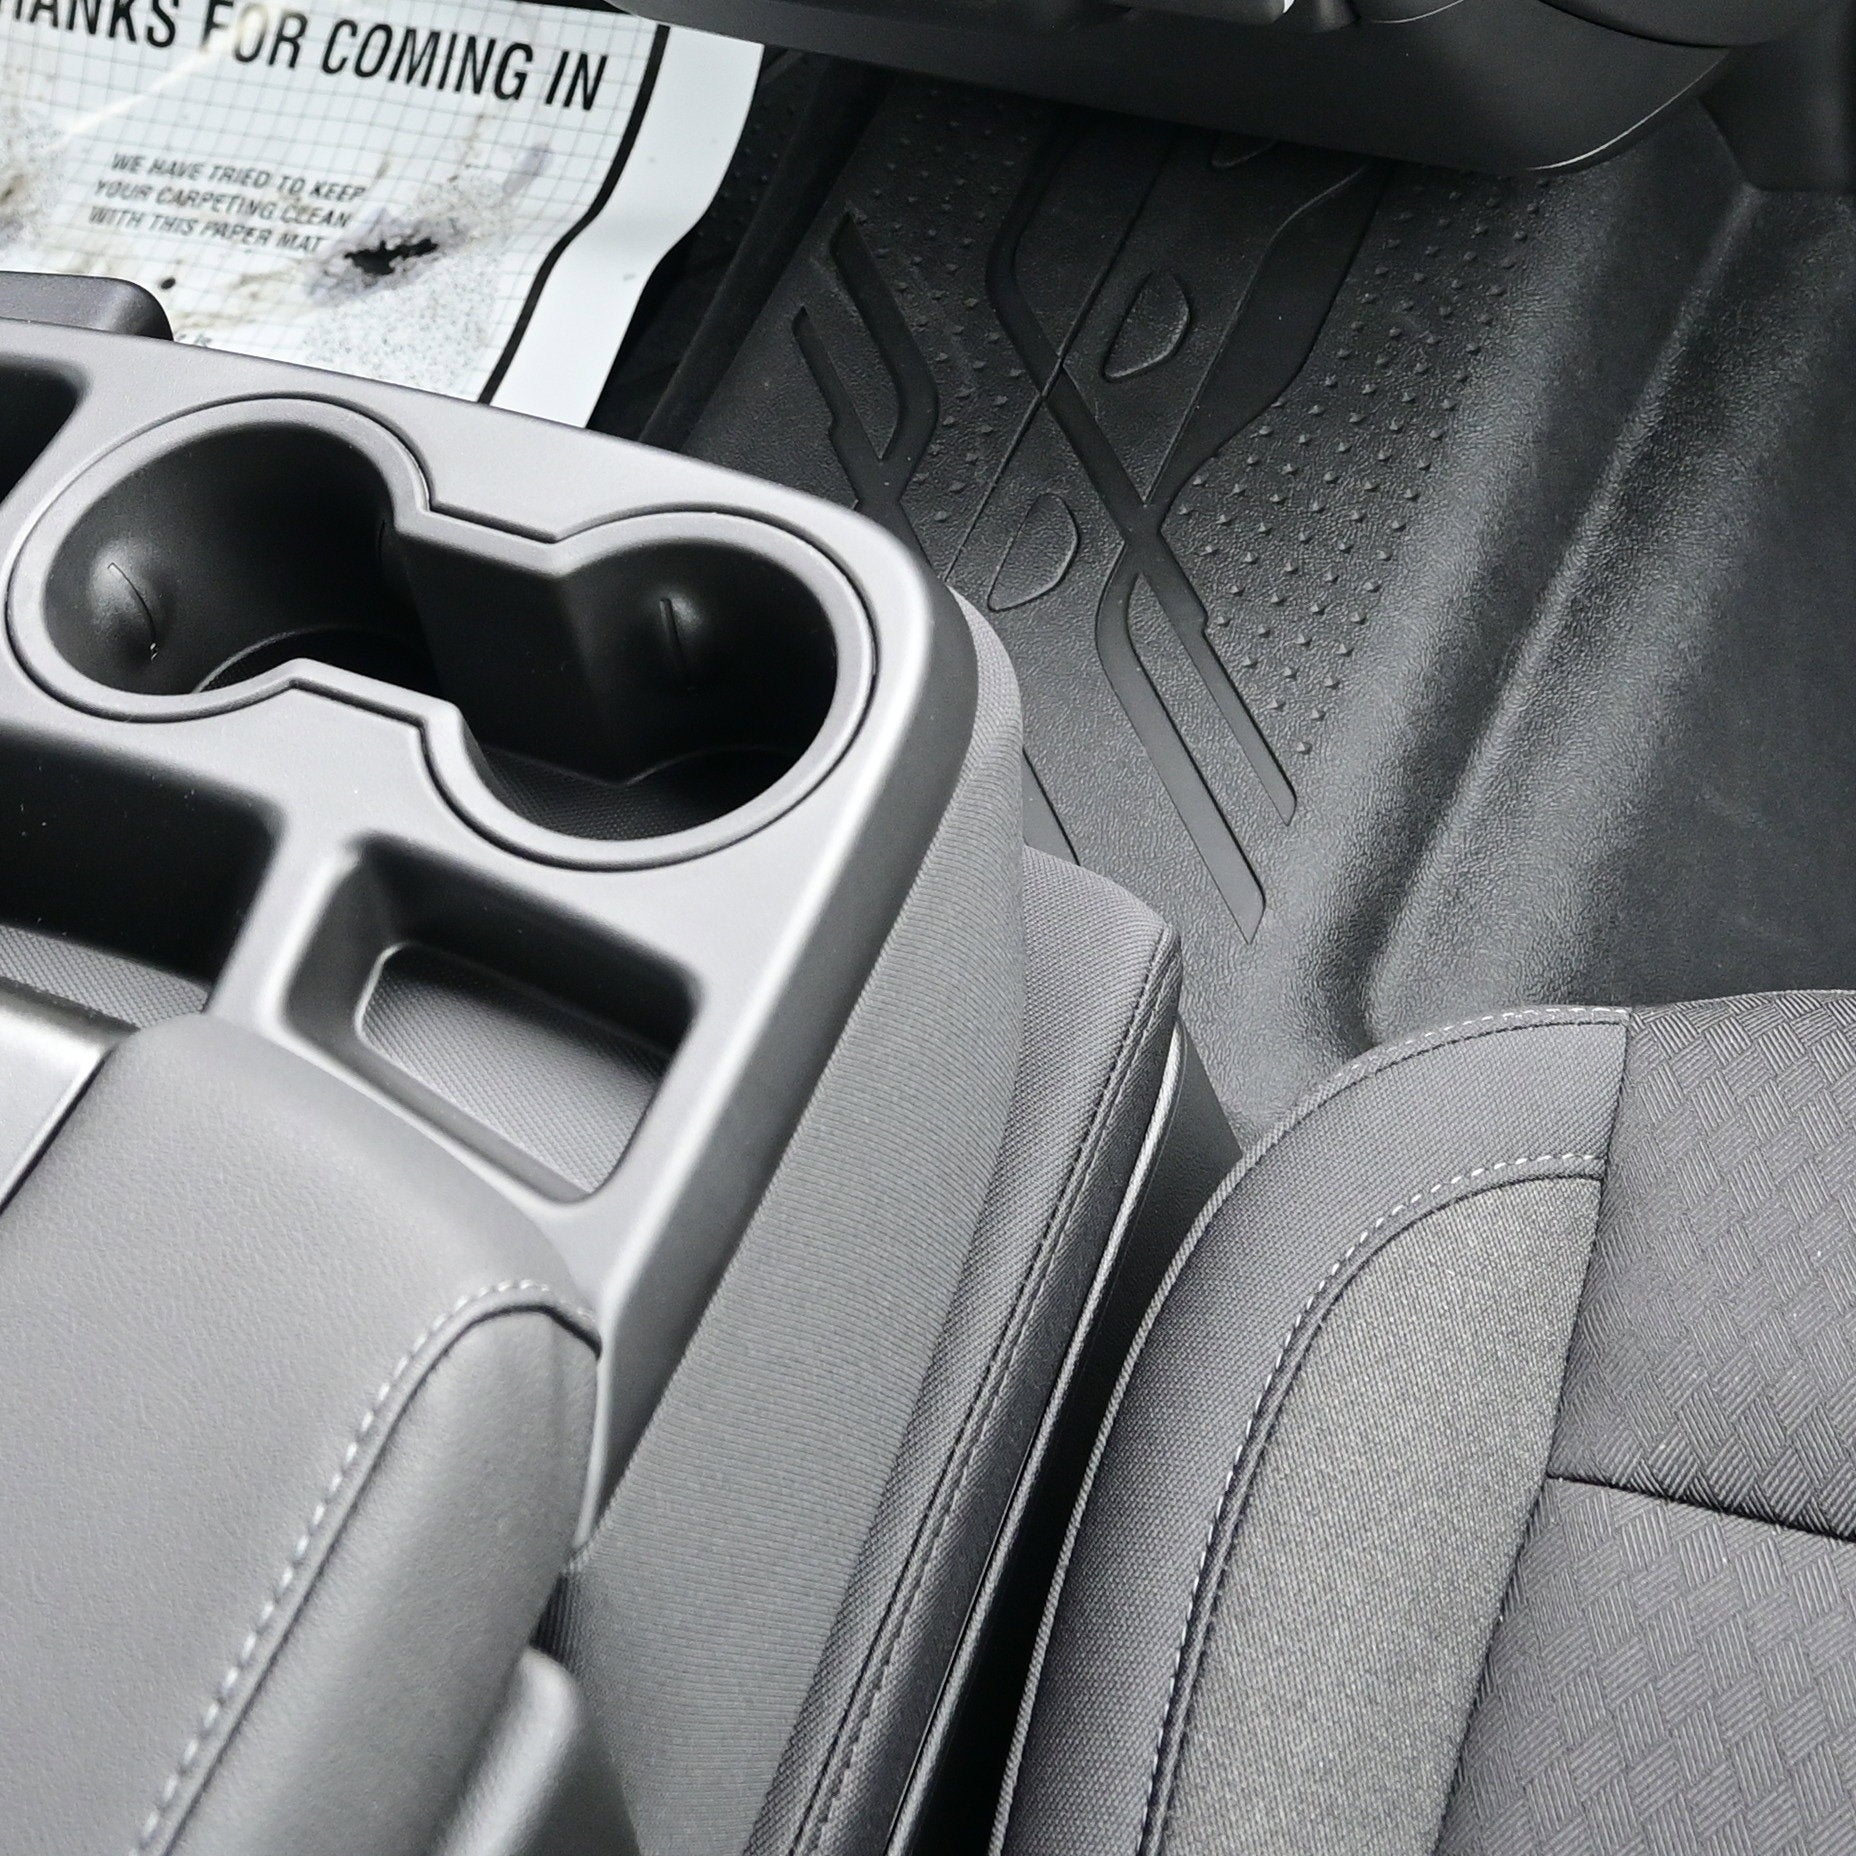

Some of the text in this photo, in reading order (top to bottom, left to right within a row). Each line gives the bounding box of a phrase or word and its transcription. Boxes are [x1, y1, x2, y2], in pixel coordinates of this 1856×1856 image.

[321, 18, 533, 100] COMING
[544, 49, 608, 112] IN
[112, 153, 366, 202] WE HAVE TRIED TO KEEP
[89, 206, 324, 252] WITH THIS PAPER MAT
[95, 180, 352, 229] YOUR CARPETING CLEAN
